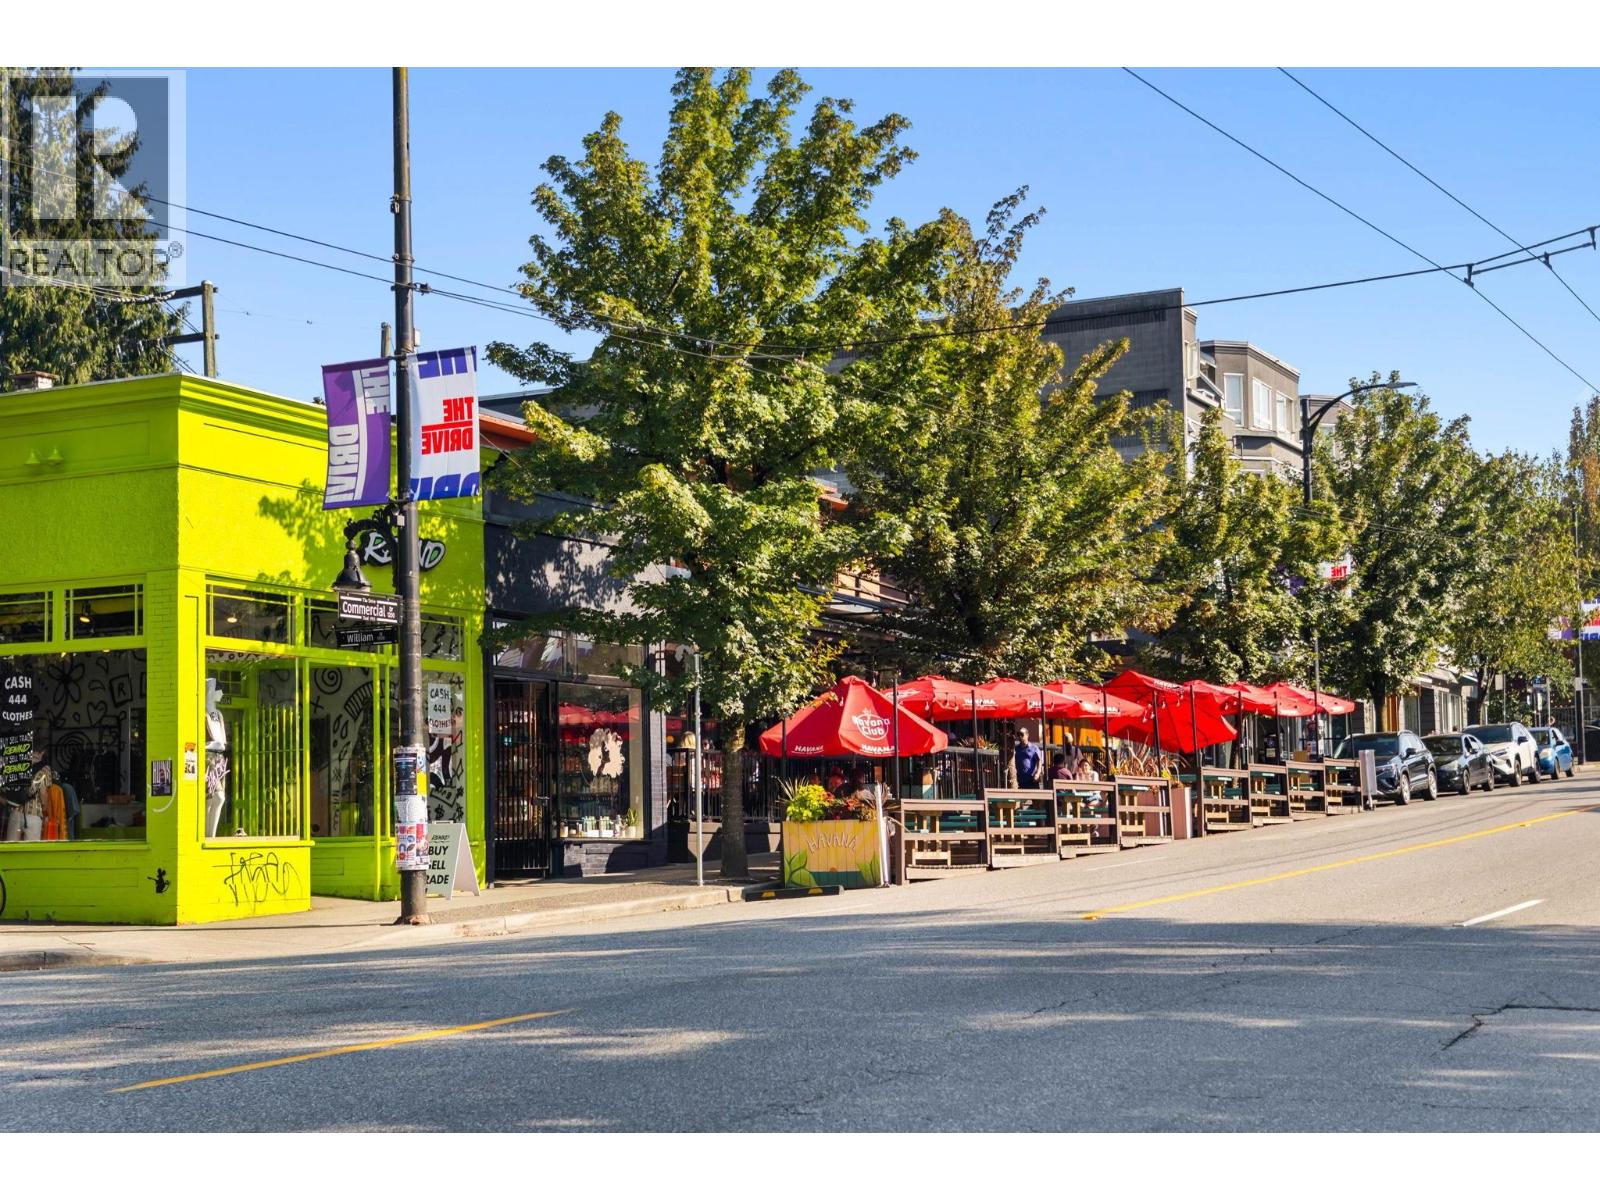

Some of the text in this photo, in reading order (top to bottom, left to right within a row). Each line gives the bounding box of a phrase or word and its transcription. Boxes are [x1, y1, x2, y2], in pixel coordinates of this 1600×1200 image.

[342, 601, 386, 618] Commercial
[4, 675, 32, 690] CASH
[8, 694, 27, 705] 444
[430, 688, 450, 700] CASH
[2, 710, 33, 722] CLOTHES
[852, 715, 890, 728] Havana
[863, 726, 884, 737] Club
[794, 744, 824, 752] HAVANA
[806, 831, 857, 856] HAVANA
[427, 845, 449, 856] BUY
[428, 860, 446, 870] ELL
